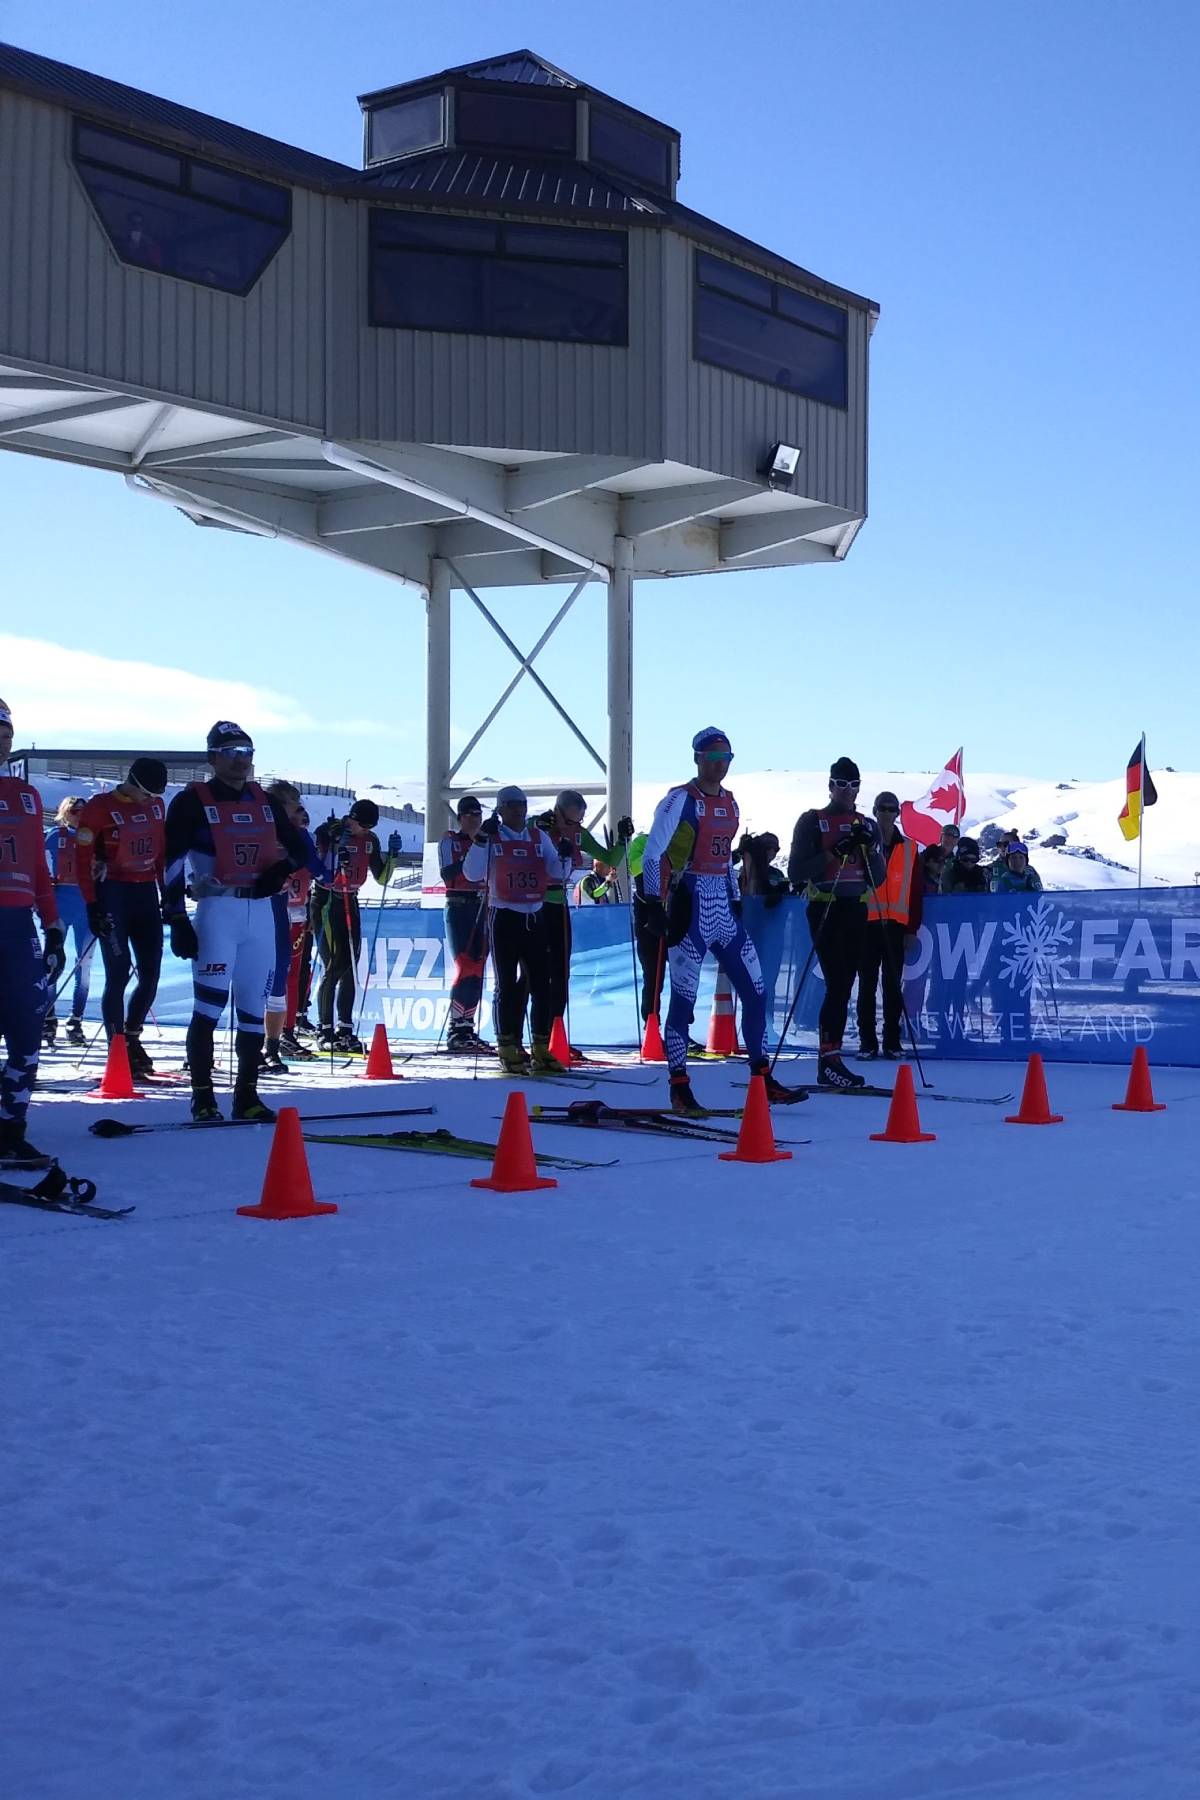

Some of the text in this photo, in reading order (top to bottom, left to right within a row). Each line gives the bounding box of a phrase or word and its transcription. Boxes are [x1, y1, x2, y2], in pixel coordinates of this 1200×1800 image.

[128, 837, 153, 857] 102
[234, 843, 260, 867] 57
[711, 836, 730, 857] 53
[506, 872, 538, 889] 135
[902, 922, 997, 981] OW
[900, 1011, 1155, 1043] NEW ZEALAND
